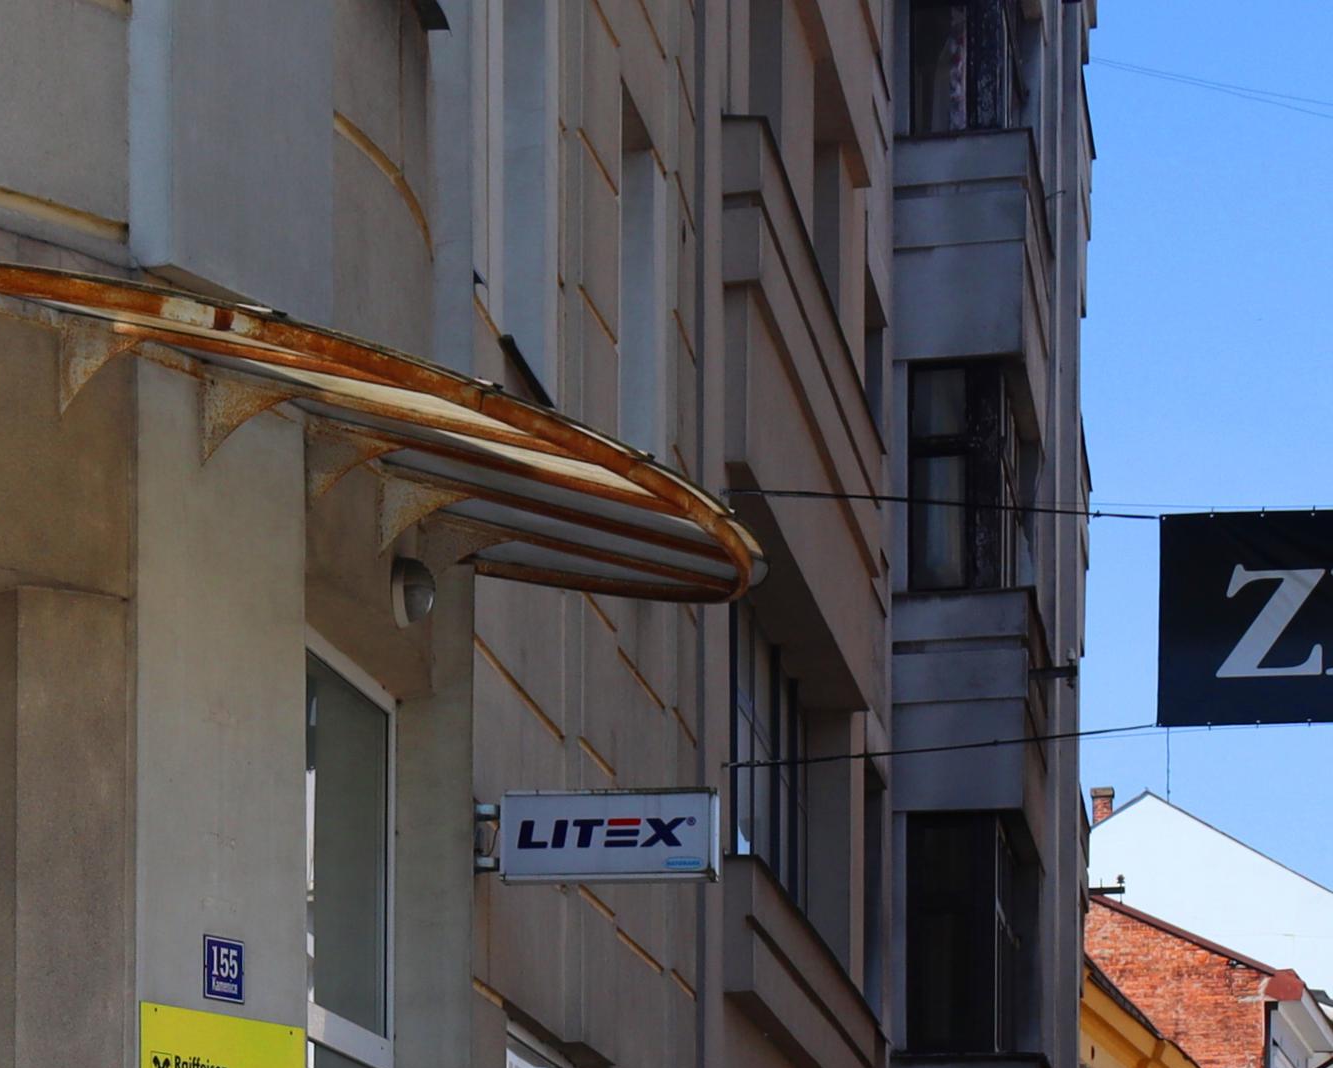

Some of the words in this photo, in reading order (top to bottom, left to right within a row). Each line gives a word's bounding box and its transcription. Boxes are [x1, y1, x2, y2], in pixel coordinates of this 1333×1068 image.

[1215, 563, 1333, 678] Z
[517, 817, 687, 850] LITEX
[212, 946, 238, 979] 155
